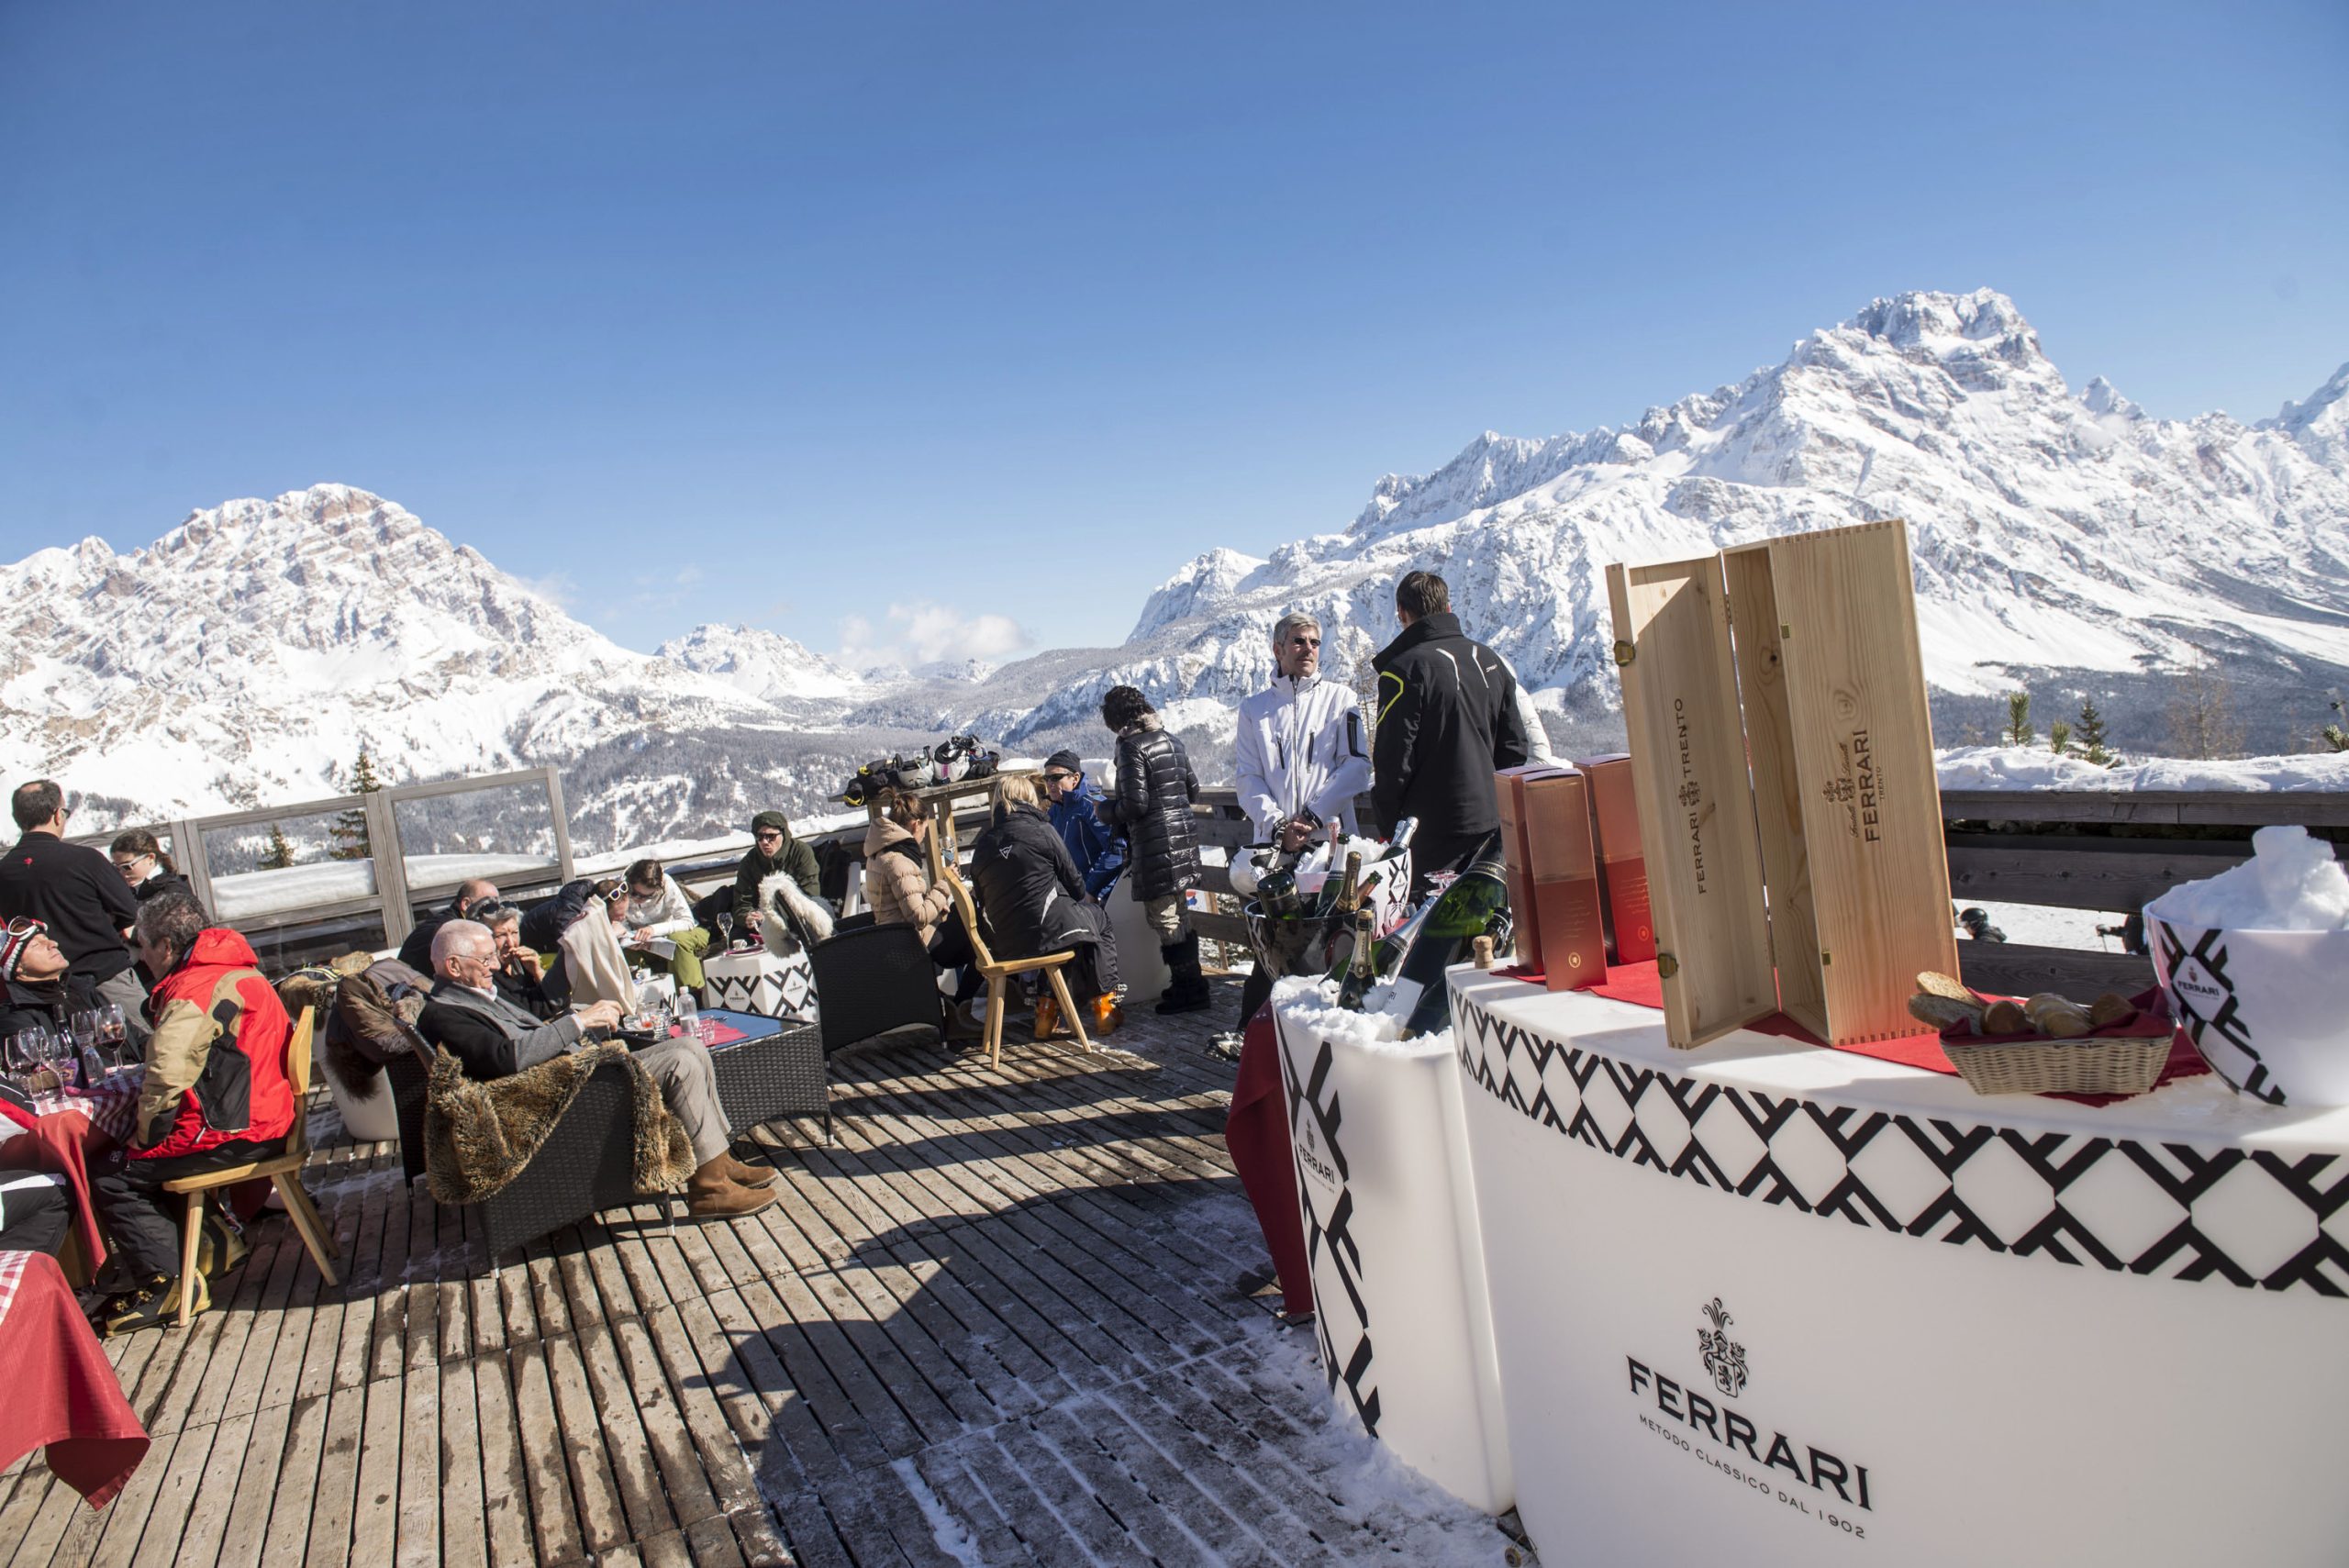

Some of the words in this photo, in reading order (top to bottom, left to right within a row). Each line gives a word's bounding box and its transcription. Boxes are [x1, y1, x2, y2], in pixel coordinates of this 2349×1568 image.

[1675, 698, 1691, 778] TRENTO
[1852, 729, 1880, 842] FERRARI
[1876, 766, 1886, 802] TRENTO
[1689, 811, 1707, 895] FERRARI
[2177, 980, 2220, 996] FERRARI
[1298, 1143, 1335, 1184] FERRARI
[1626, 1354, 1873, 1513] FERRARI
[1639, 1414, 1690, 1451] METODO
[1695, 1448, 1771, 1496] CLASSICO
[1777, 1491, 1810, 1515] DAL
[1818, 1509, 1865, 1540] 1902
